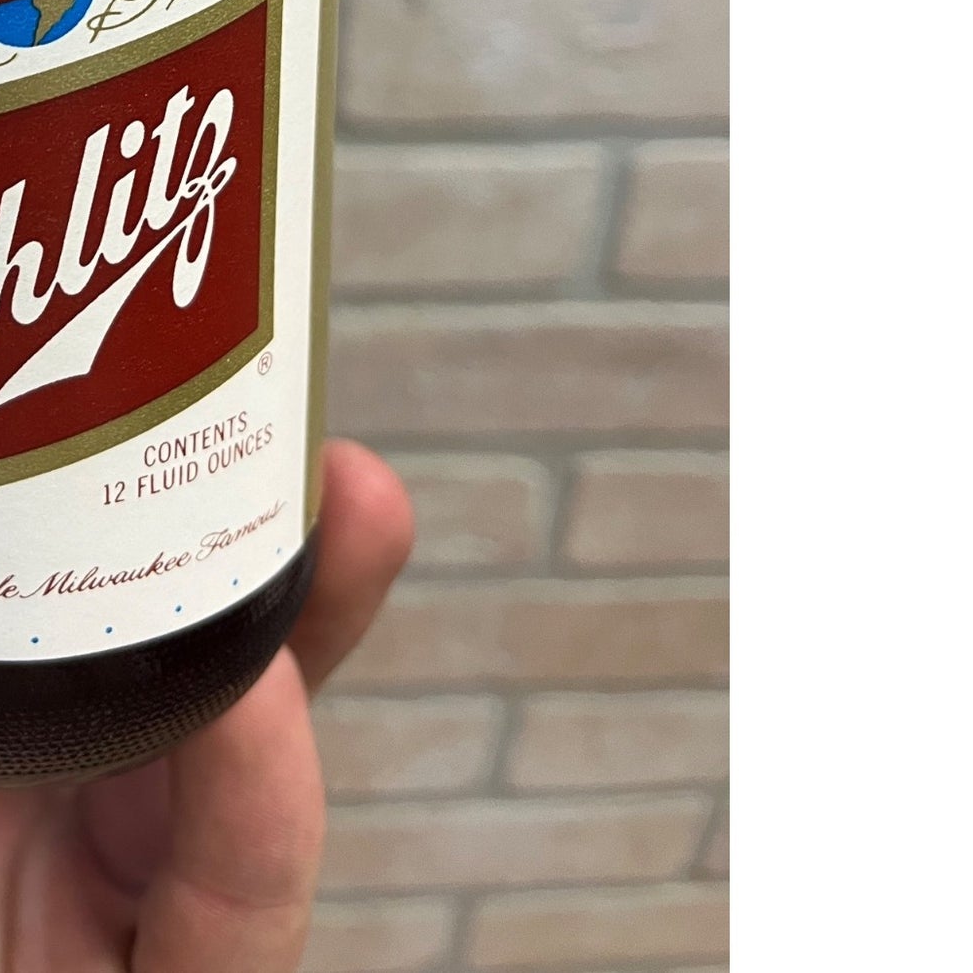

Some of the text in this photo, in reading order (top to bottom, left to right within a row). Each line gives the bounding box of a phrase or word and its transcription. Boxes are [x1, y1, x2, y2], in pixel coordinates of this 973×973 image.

[103, 423, 274, 506] 12 FLUID OUNCES
[143, 411, 248, 468] CONTENTS
[20, 552, 192, 599] Milwaukee
[199, 501, 287, 560] Famous
